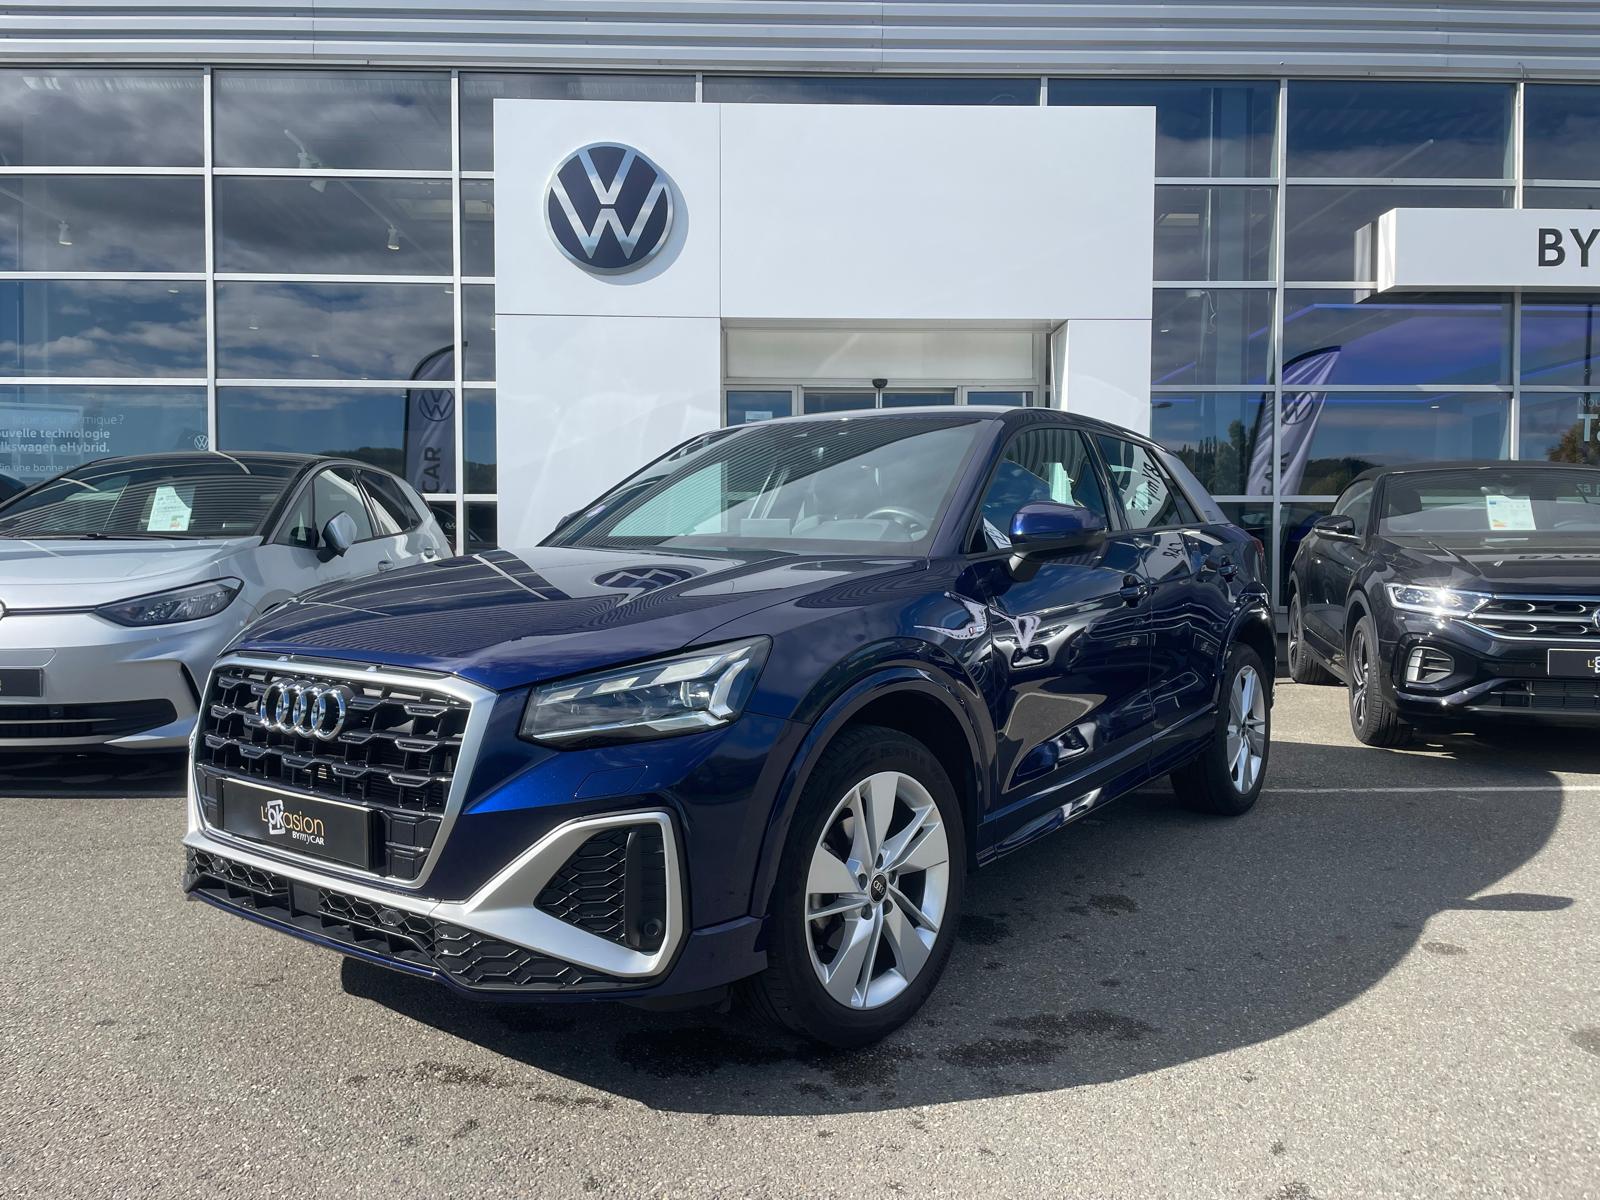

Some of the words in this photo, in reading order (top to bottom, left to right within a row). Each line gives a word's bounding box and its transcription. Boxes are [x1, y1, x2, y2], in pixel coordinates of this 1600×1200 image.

[1538, 228, 1600, 267] BY
[40, 428, 110, 440] technologie
[60, 442, 110, 455] eHybrid.
[33, 463, 63, 472] bonne
[292, 831, 325, 845] BYmyCAR
